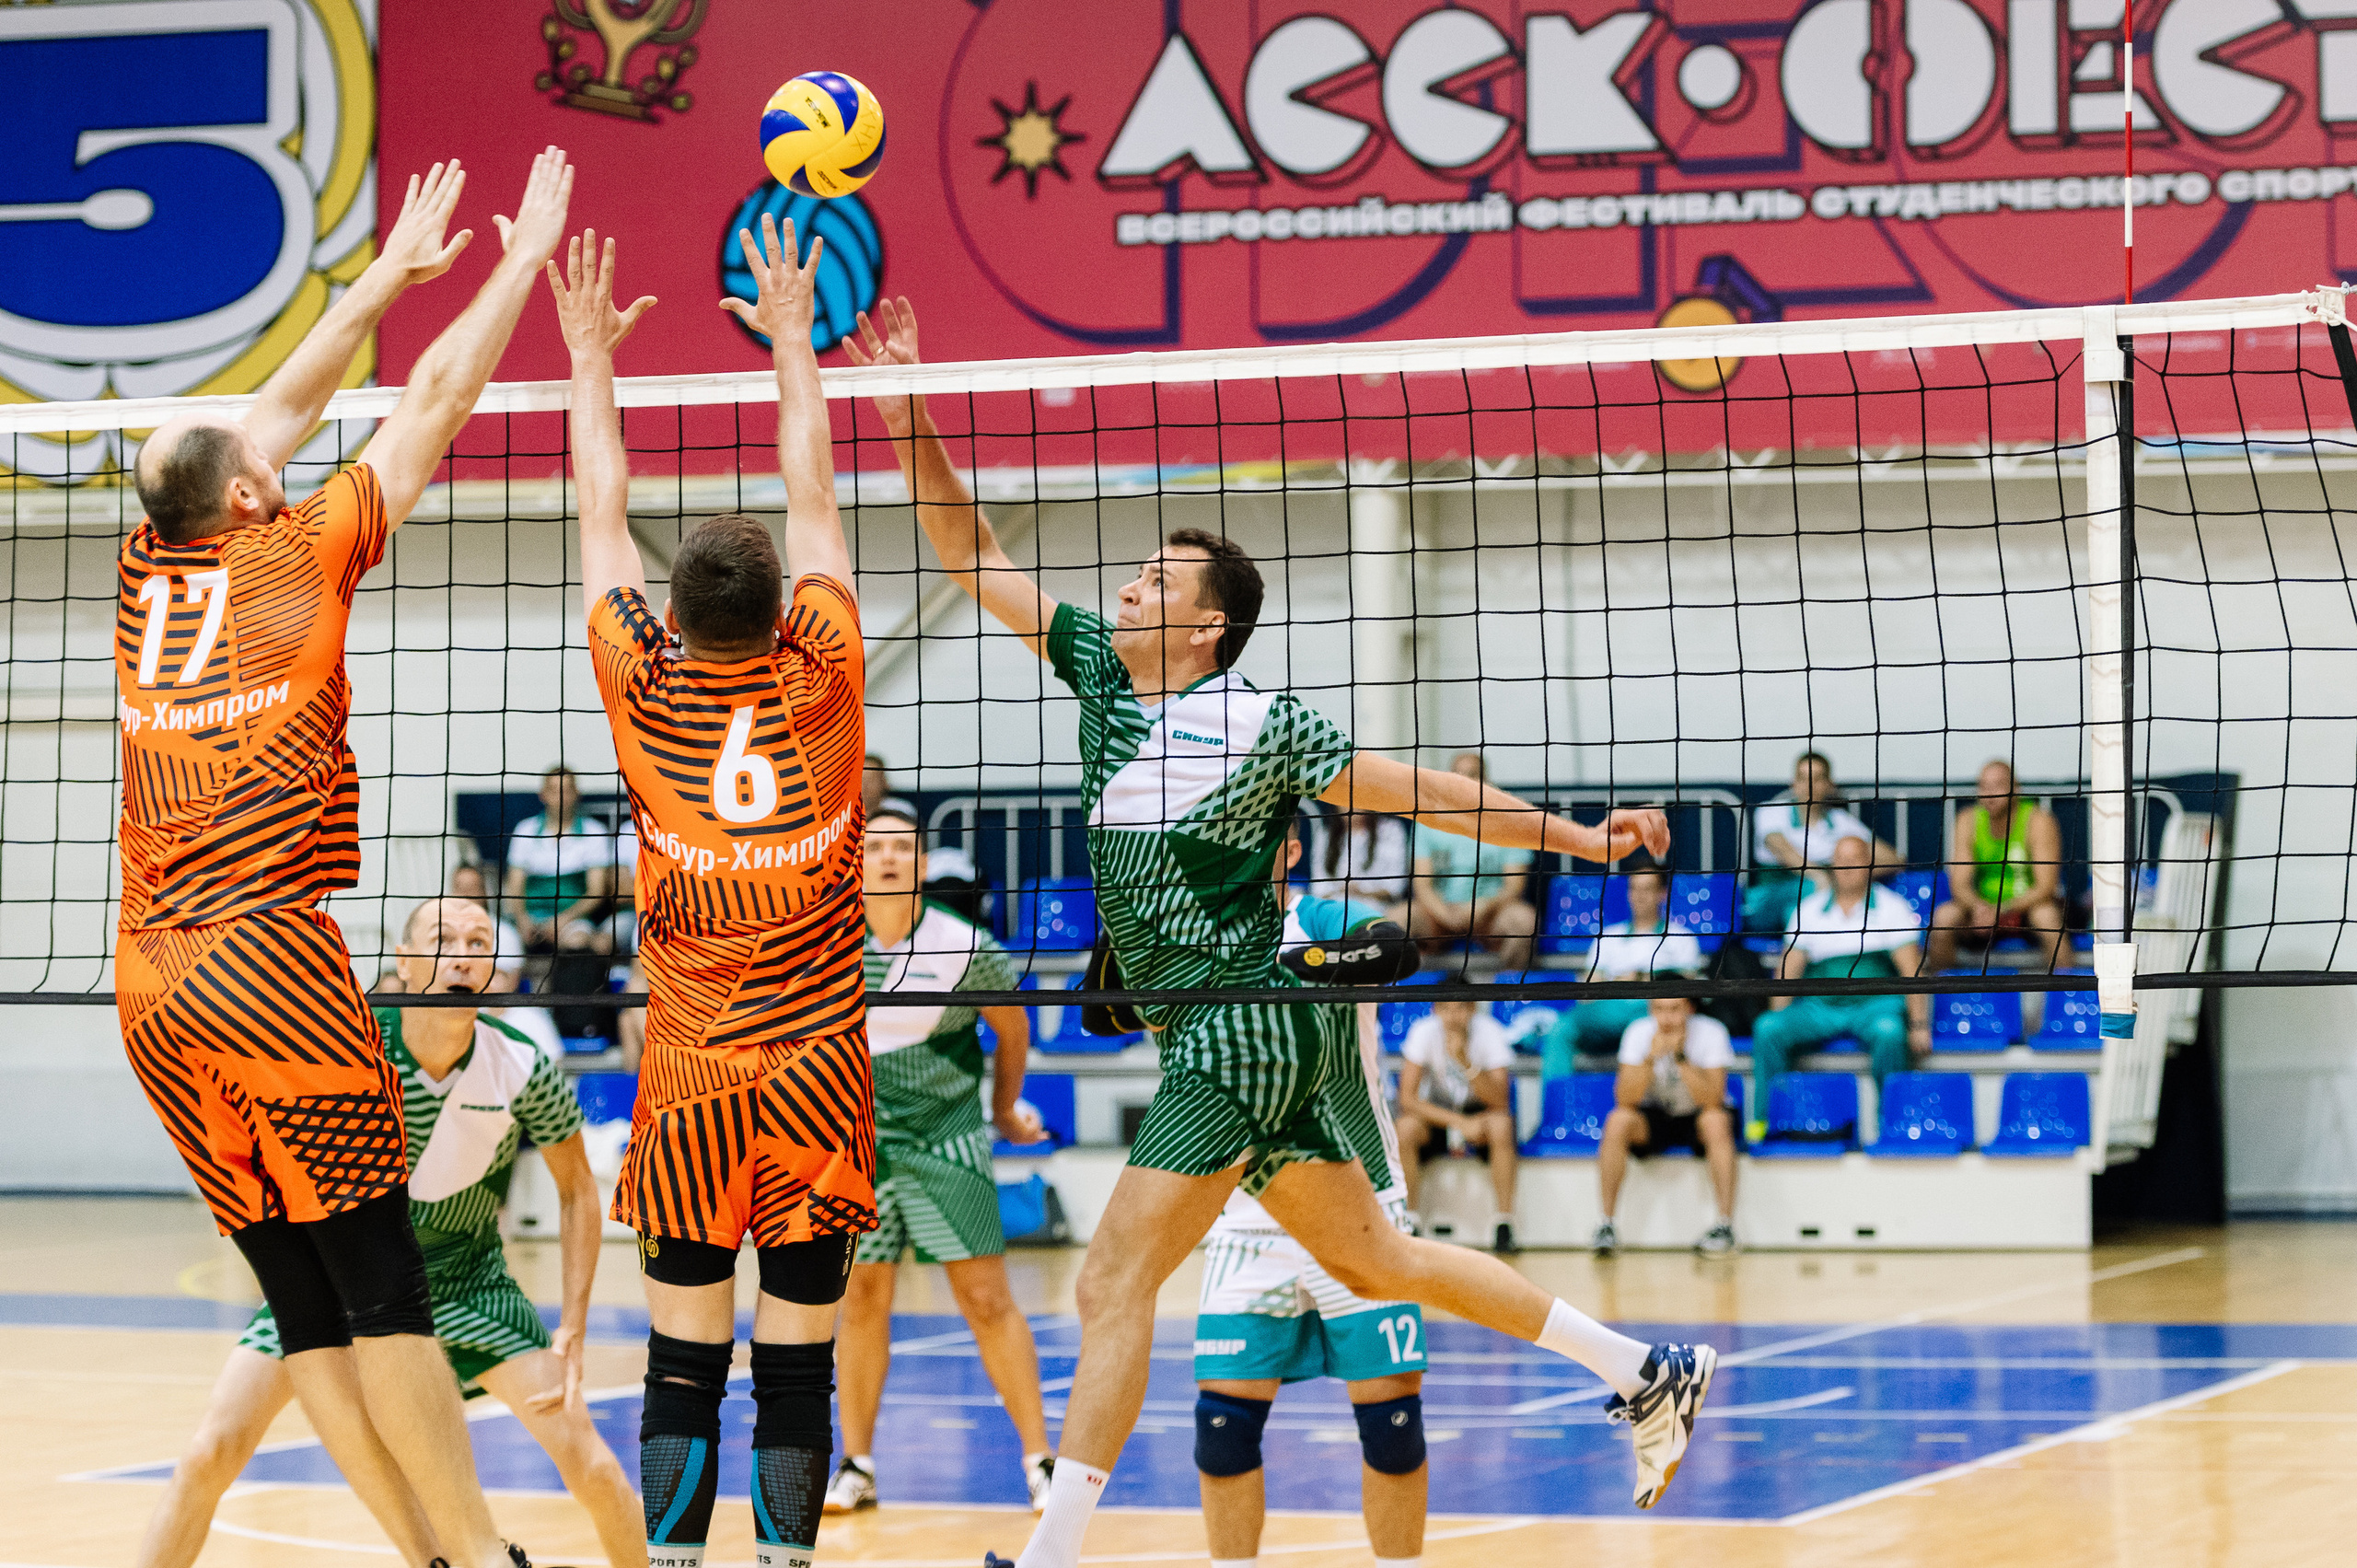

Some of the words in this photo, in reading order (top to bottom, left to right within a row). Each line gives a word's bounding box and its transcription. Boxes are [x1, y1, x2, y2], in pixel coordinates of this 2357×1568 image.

[1117, 192, 1513, 245] ВСЕРОССИЙСКИЙ
[1518, 188, 1805, 230] ФЕСТИВАЛЬ
[1812, 172, 2210, 220] СТУДЕНЧЕСКОГО
[2219, 167, 2357, 203] СПОР
[138, 567, 228, 684] 17
[714, 705, 777, 823] 6
[642, 800, 852, 876] Сибур-Химпром
[1377, 1314, 1423, 1365] 12
[647, 1557, 697, 1567] PORTS
